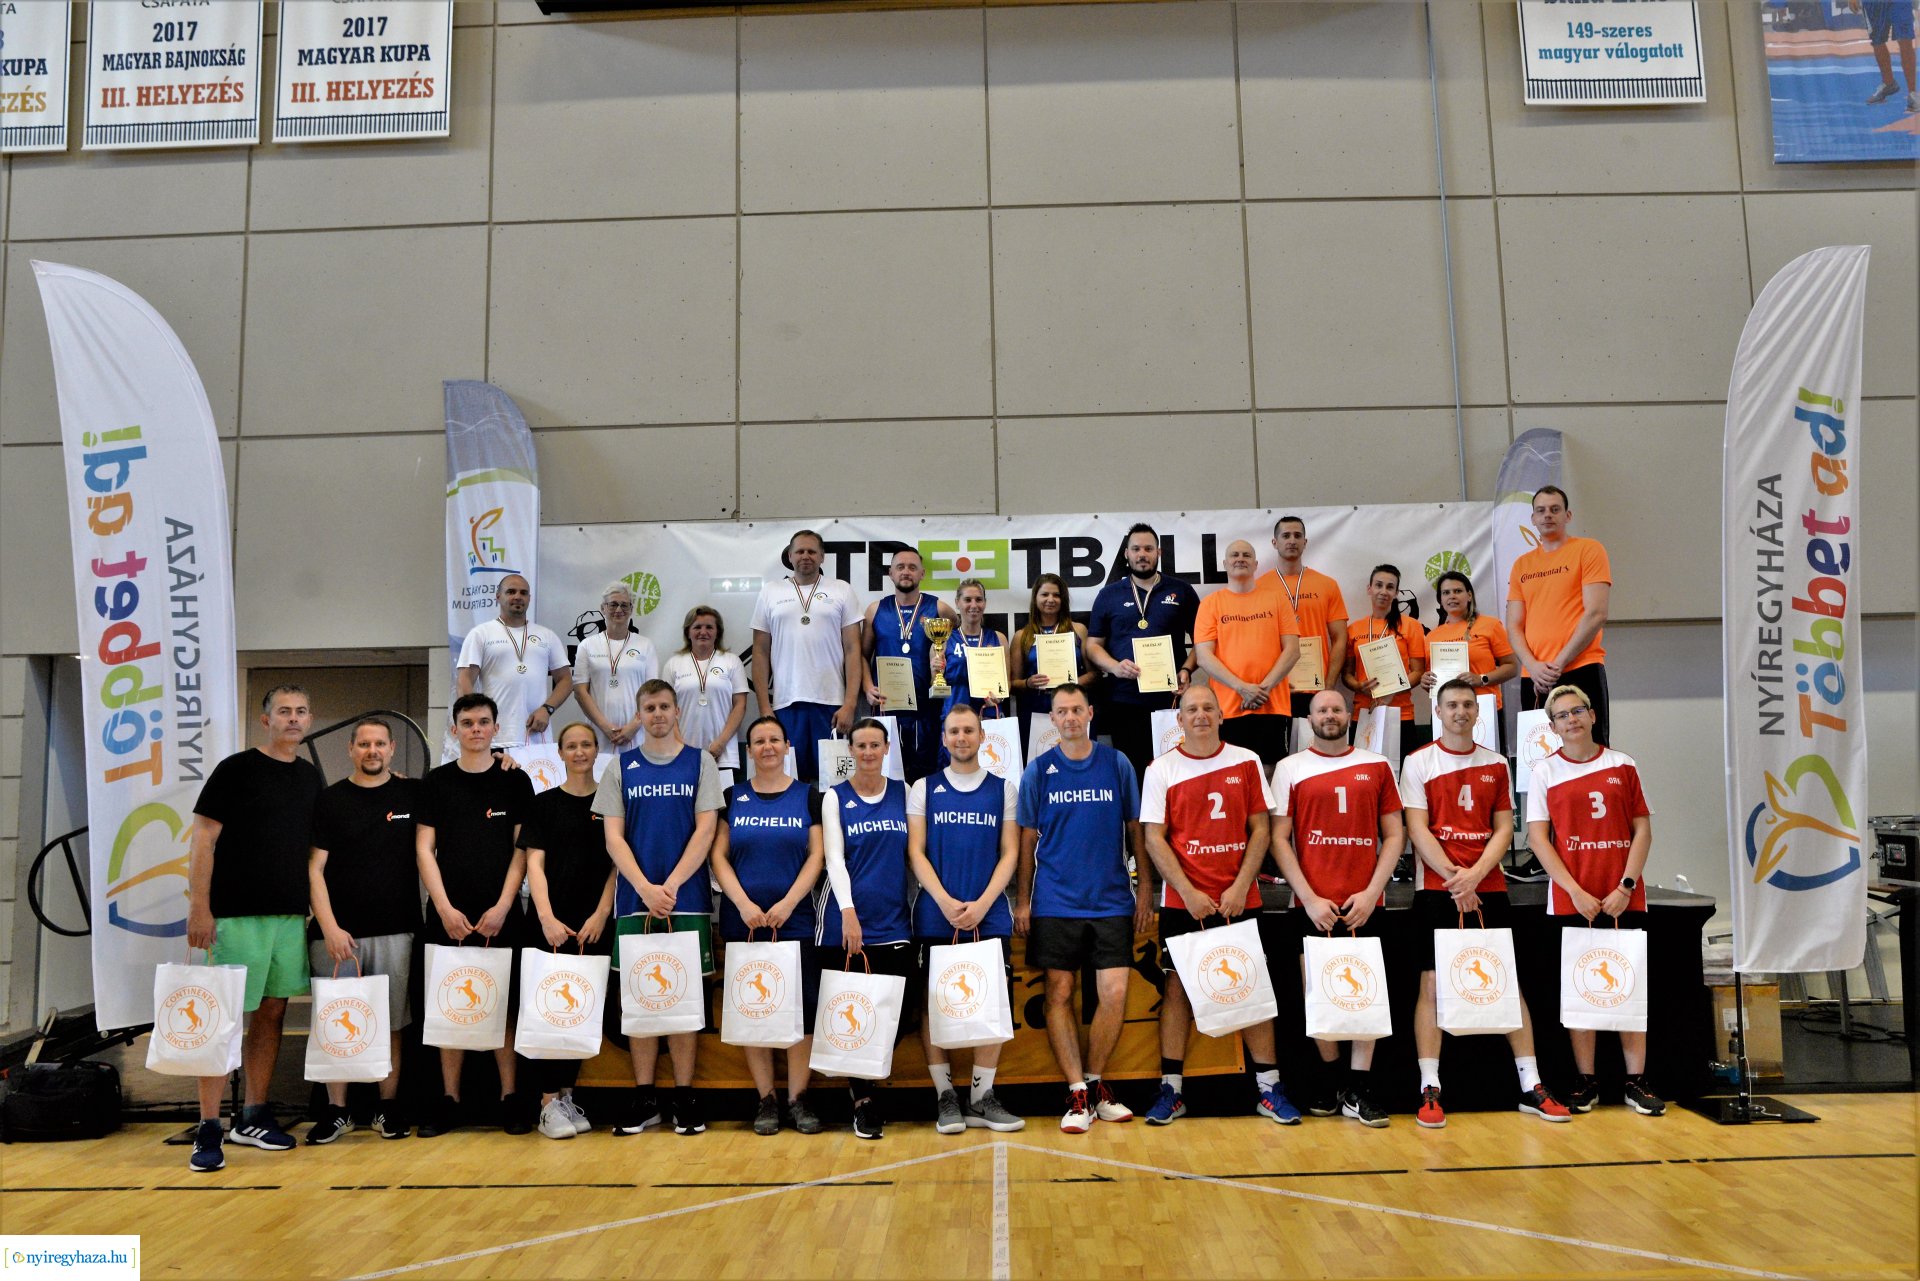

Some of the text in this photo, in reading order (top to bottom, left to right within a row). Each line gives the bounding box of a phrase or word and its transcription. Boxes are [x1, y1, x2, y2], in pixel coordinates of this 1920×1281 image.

[153, 21, 198, 43] 2017
[342, 16, 388, 38] 2017
[1567, 22, 1653, 38] 149-szeres
[102, 43, 246, 71] MAGYAR BAJNOKSÁG
[297, 44, 431, 66] MAGYAR KUPA
[1538, 42, 1684, 63] magyar válogatott
[101, 76, 244, 108] III. HELYEZÉS
[291, 71, 434, 103] III. HELYEZÉS
[1791, 386, 1850, 738] Többet ad!
[1750, 473, 1785, 735] NYÍREGYHÁZA
[628, 784, 694, 800] MICHELIN
[1049, 789, 1113, 804] MICHELIN
[1334, 786, 1347, 814] 1
[1457, 784, 1474, 811] 4
[1207, 792, 1226, 820] 2
[1588, 791, 1607, 819] 3
[734, 816, 803, 828] MICHELIN
[847, 819, 908, 837] MICHELIN
[933, 811, 997, 827] MICHELIN
[1200, 842, 1246, 854] marso
[1322, 837, 1373, 847] marso
[1580, 841, 1631, 849] marso
[633, 954, 683, 975] CONTINENTAL
[1200, 947, 1249, 972] CONTINENTAL
[1324, 956, 1371, 977] CONTINENTAL
[1453, 949, 1501, 969] CONTINENTAL
[1578, 950, 1631, 972] CONTINENTAL
[443, 968, 494, 989] CONTINENTAL
[736, 962, 783, 982] CONTINENTAL
[940, 963, 985, 985] CONTINENTAL
[541, 973, 591, 994] CONTINENTAL
[166, 987, 216, 1010] CONTINENTAL
[639, 996, 661, 1009] SINCE
[828, 992, 873, 1016] CONTINENTAL
[1211, 992, 1235, 1002] SINCE
[1332, 996, 1355, 1010] SINCE
[1461, 989, 1484, 1004] SINCE
[1582, 991, 1607, 1007] SINCE
[320, 999, 373, 1021] CONTINENTAL
[444, 1008, 467, 1023] SINCE
[543, 1011, 566, 1027] SINCE
[738, 1004, 760, 1017] SINCE
[943, 1005, 963, 1017] SINCE
[165, 1032, 188, 1048] SINCE
[322, 1042, 348, 1056] SINCE
[828, 1034, 848, 1049] SINCE
